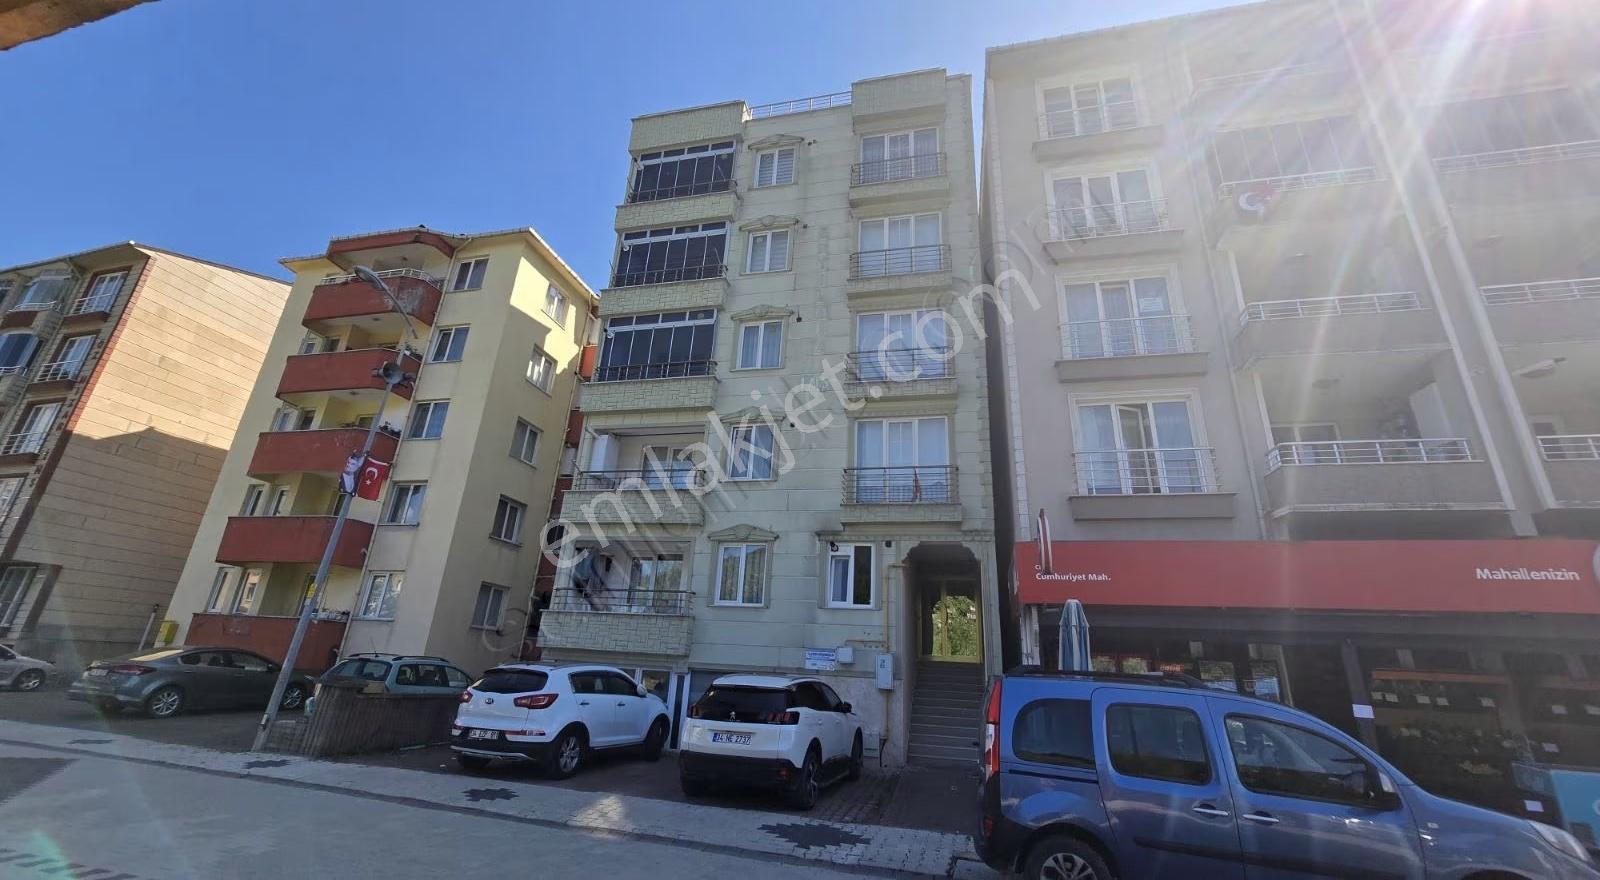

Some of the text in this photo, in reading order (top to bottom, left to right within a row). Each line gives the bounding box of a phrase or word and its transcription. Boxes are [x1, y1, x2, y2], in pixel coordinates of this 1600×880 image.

[1035, 572, 1111, 582] Cumhuriyet Mah.
[1475, 567, 1581, 581] Mahallenizin
